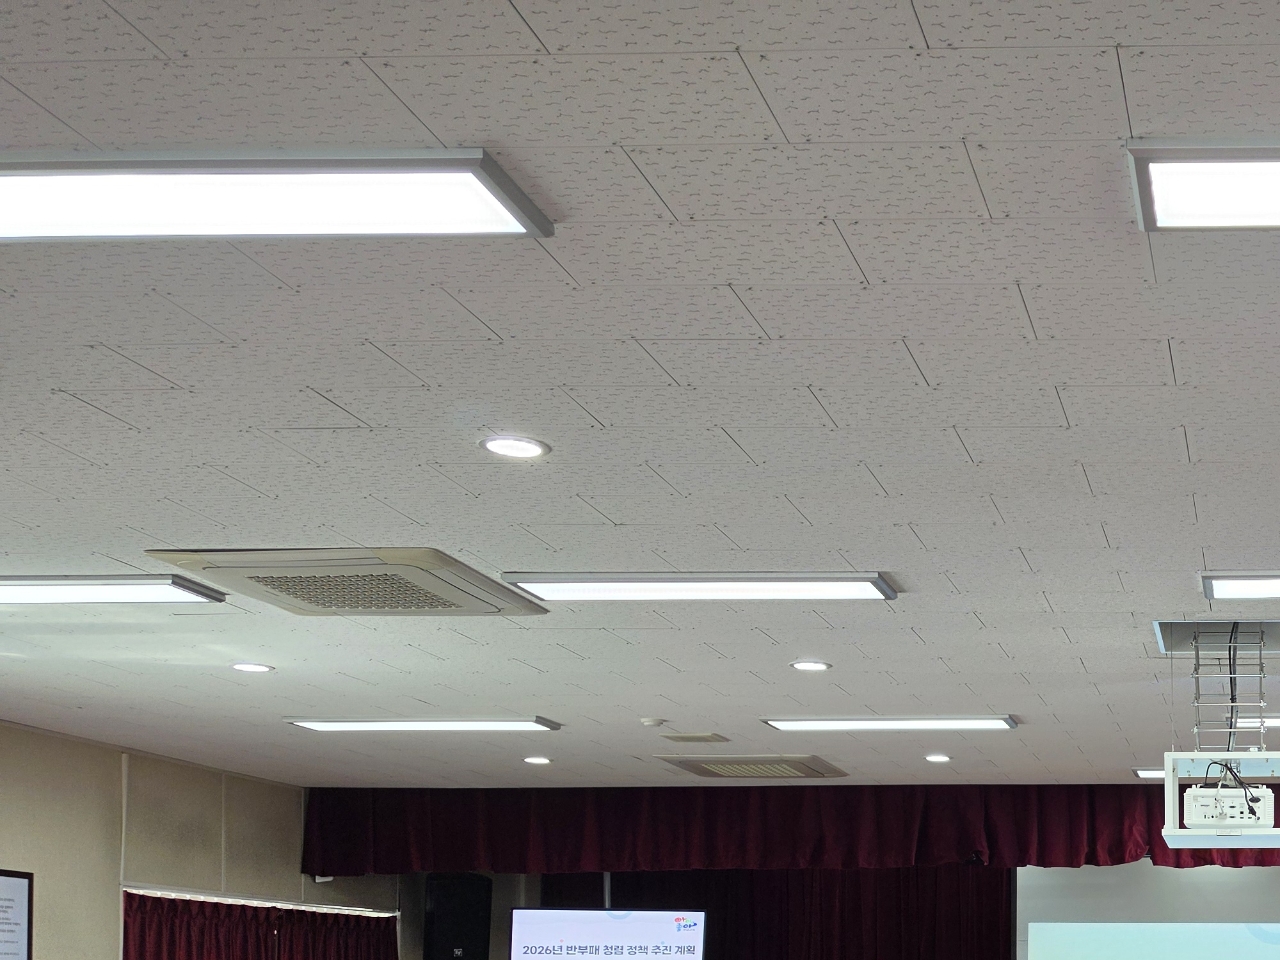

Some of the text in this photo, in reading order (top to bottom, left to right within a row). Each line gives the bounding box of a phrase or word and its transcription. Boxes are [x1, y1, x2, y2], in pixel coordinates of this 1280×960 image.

[522, 945, 696, 956] 2026년 반부패 청렴 정책 추진 계획
